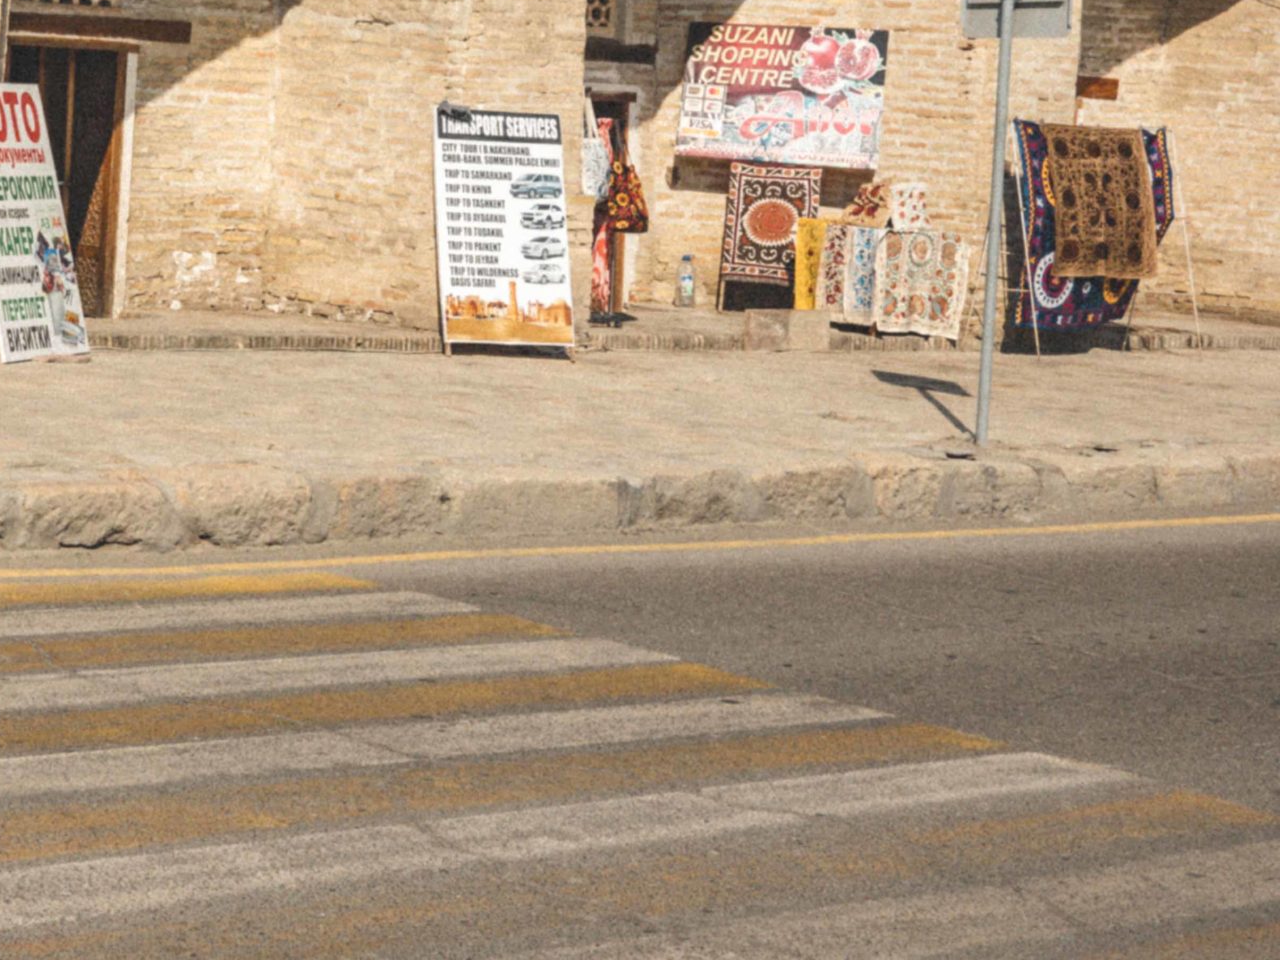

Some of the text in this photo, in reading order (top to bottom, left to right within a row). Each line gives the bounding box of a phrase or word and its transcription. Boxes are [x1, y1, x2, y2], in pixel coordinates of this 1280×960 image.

[709, 25, 795, 46] SUZANI
[690, 44, 808, 67] SHOPPING
[699, 65, 794, 88] CENTRE
[505, 116, 559, 140] SERVICES
[442, 143, 457, 152] CITY
[460, 144, 478, 153] TOUR
[484, 155, 514, 166] SUMMER
[445, 169, 513, 181] TRIP TO SAMARKAND
[445, 183, 492, 194] TRIP TO KHIVA
[446, 197, 505, 208] TRIP TO TASHKENT
[446, 212, 461, 221] TRIP
[463, 212, 471, 222] TO
[447, 226, 462, 236] TRIP
[464, 227, 472, 236] TO
[448, 241, 463, 250] TRIP
[465, 241, 473, 251] TO
[449, 254, 463, 263] TRIP
[465, 254, 474, 264] TO
[450, 266, 519, 278] TRIP TO WILDERNESS
[450, 277, 496, 288] OASIS SAFARI
[6, 324, 52, 352] ВИЗИТКИ
